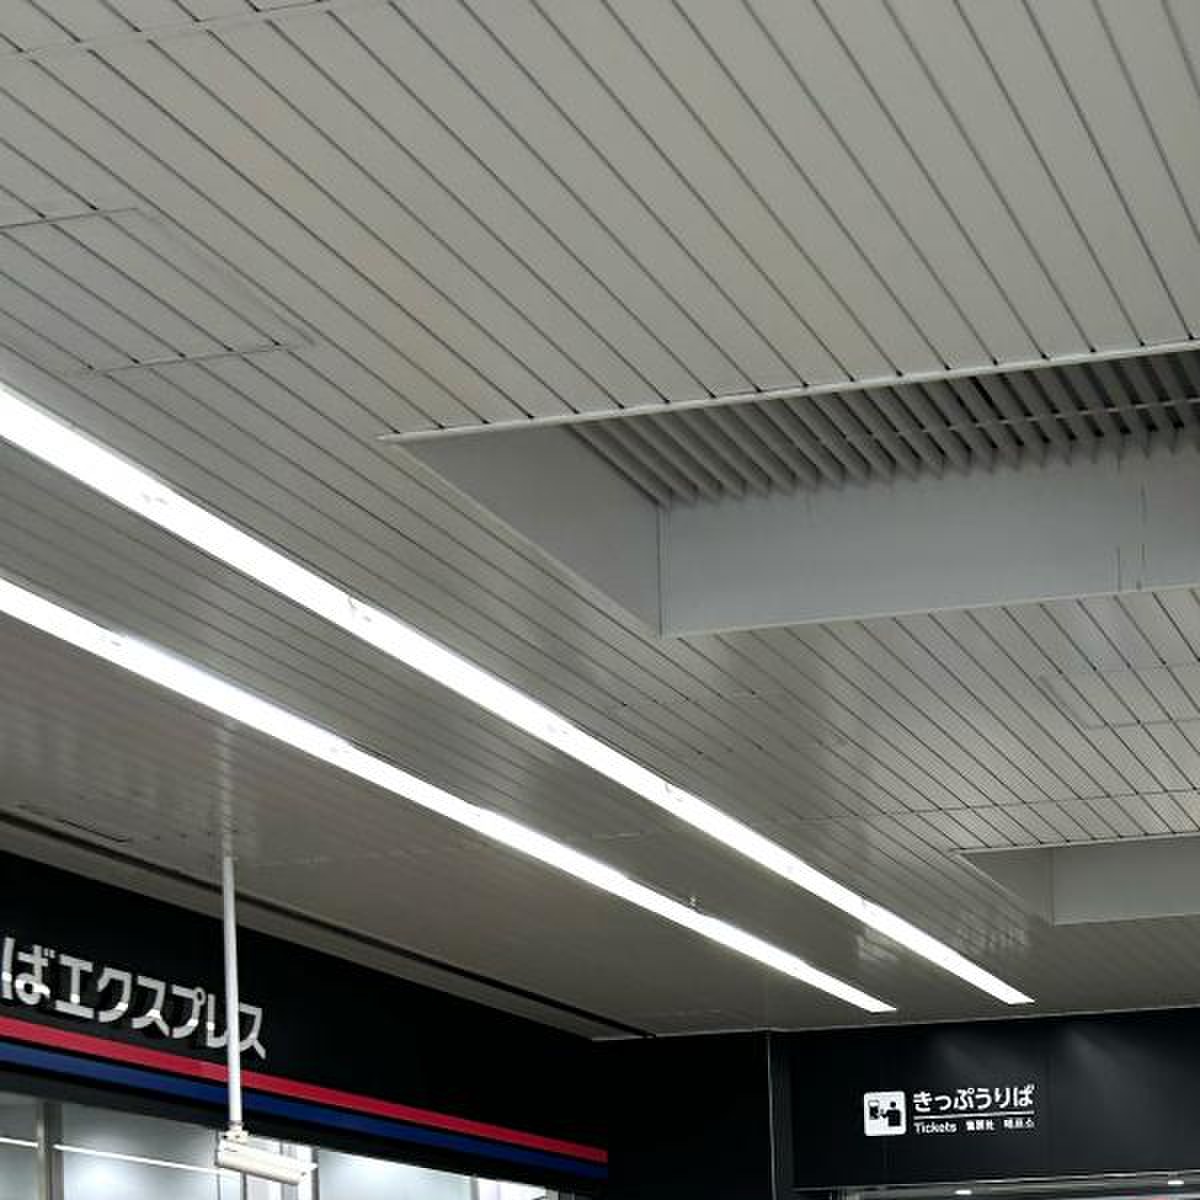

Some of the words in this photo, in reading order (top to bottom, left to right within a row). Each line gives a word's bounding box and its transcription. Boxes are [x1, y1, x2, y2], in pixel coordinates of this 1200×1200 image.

[913, 1084, 1035, 1112] きっぷうりば
[914, 1121, 957, 1133] Tickets
